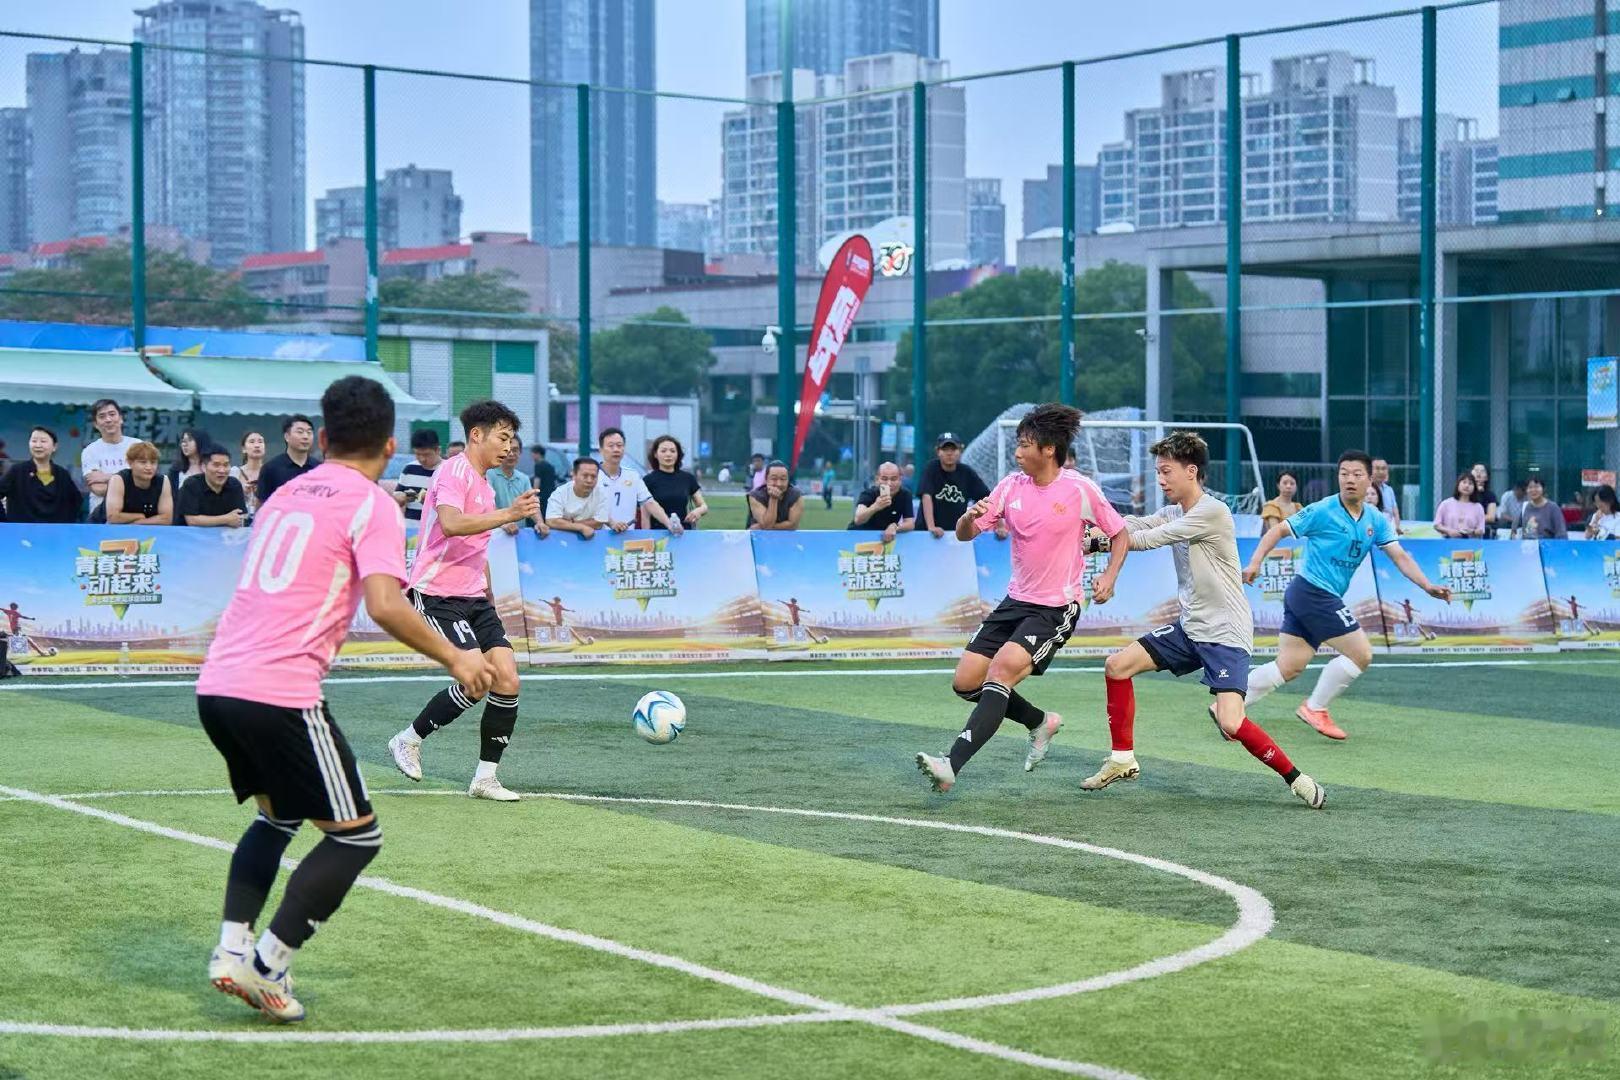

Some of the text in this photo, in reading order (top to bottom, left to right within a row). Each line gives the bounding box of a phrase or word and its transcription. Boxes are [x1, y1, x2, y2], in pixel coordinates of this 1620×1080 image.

[614, 491, 621, 507] 7
[240, 510, 315, 594] 10
[1348, 540, 1363, 559] 15
[75, 554, 160, 577] 青春芒果
[605, 551, 673, 573] 青春芒果
[837, 554, 901, 575] 青春芒果
[88, 573, 153, 595] 动起来
[615, 570, 670, 591] 动起来
[847, 571, 898, 591] 动起来
[1336, 607, 1358, 628] 15
[453, 619, 477, 644] 19
